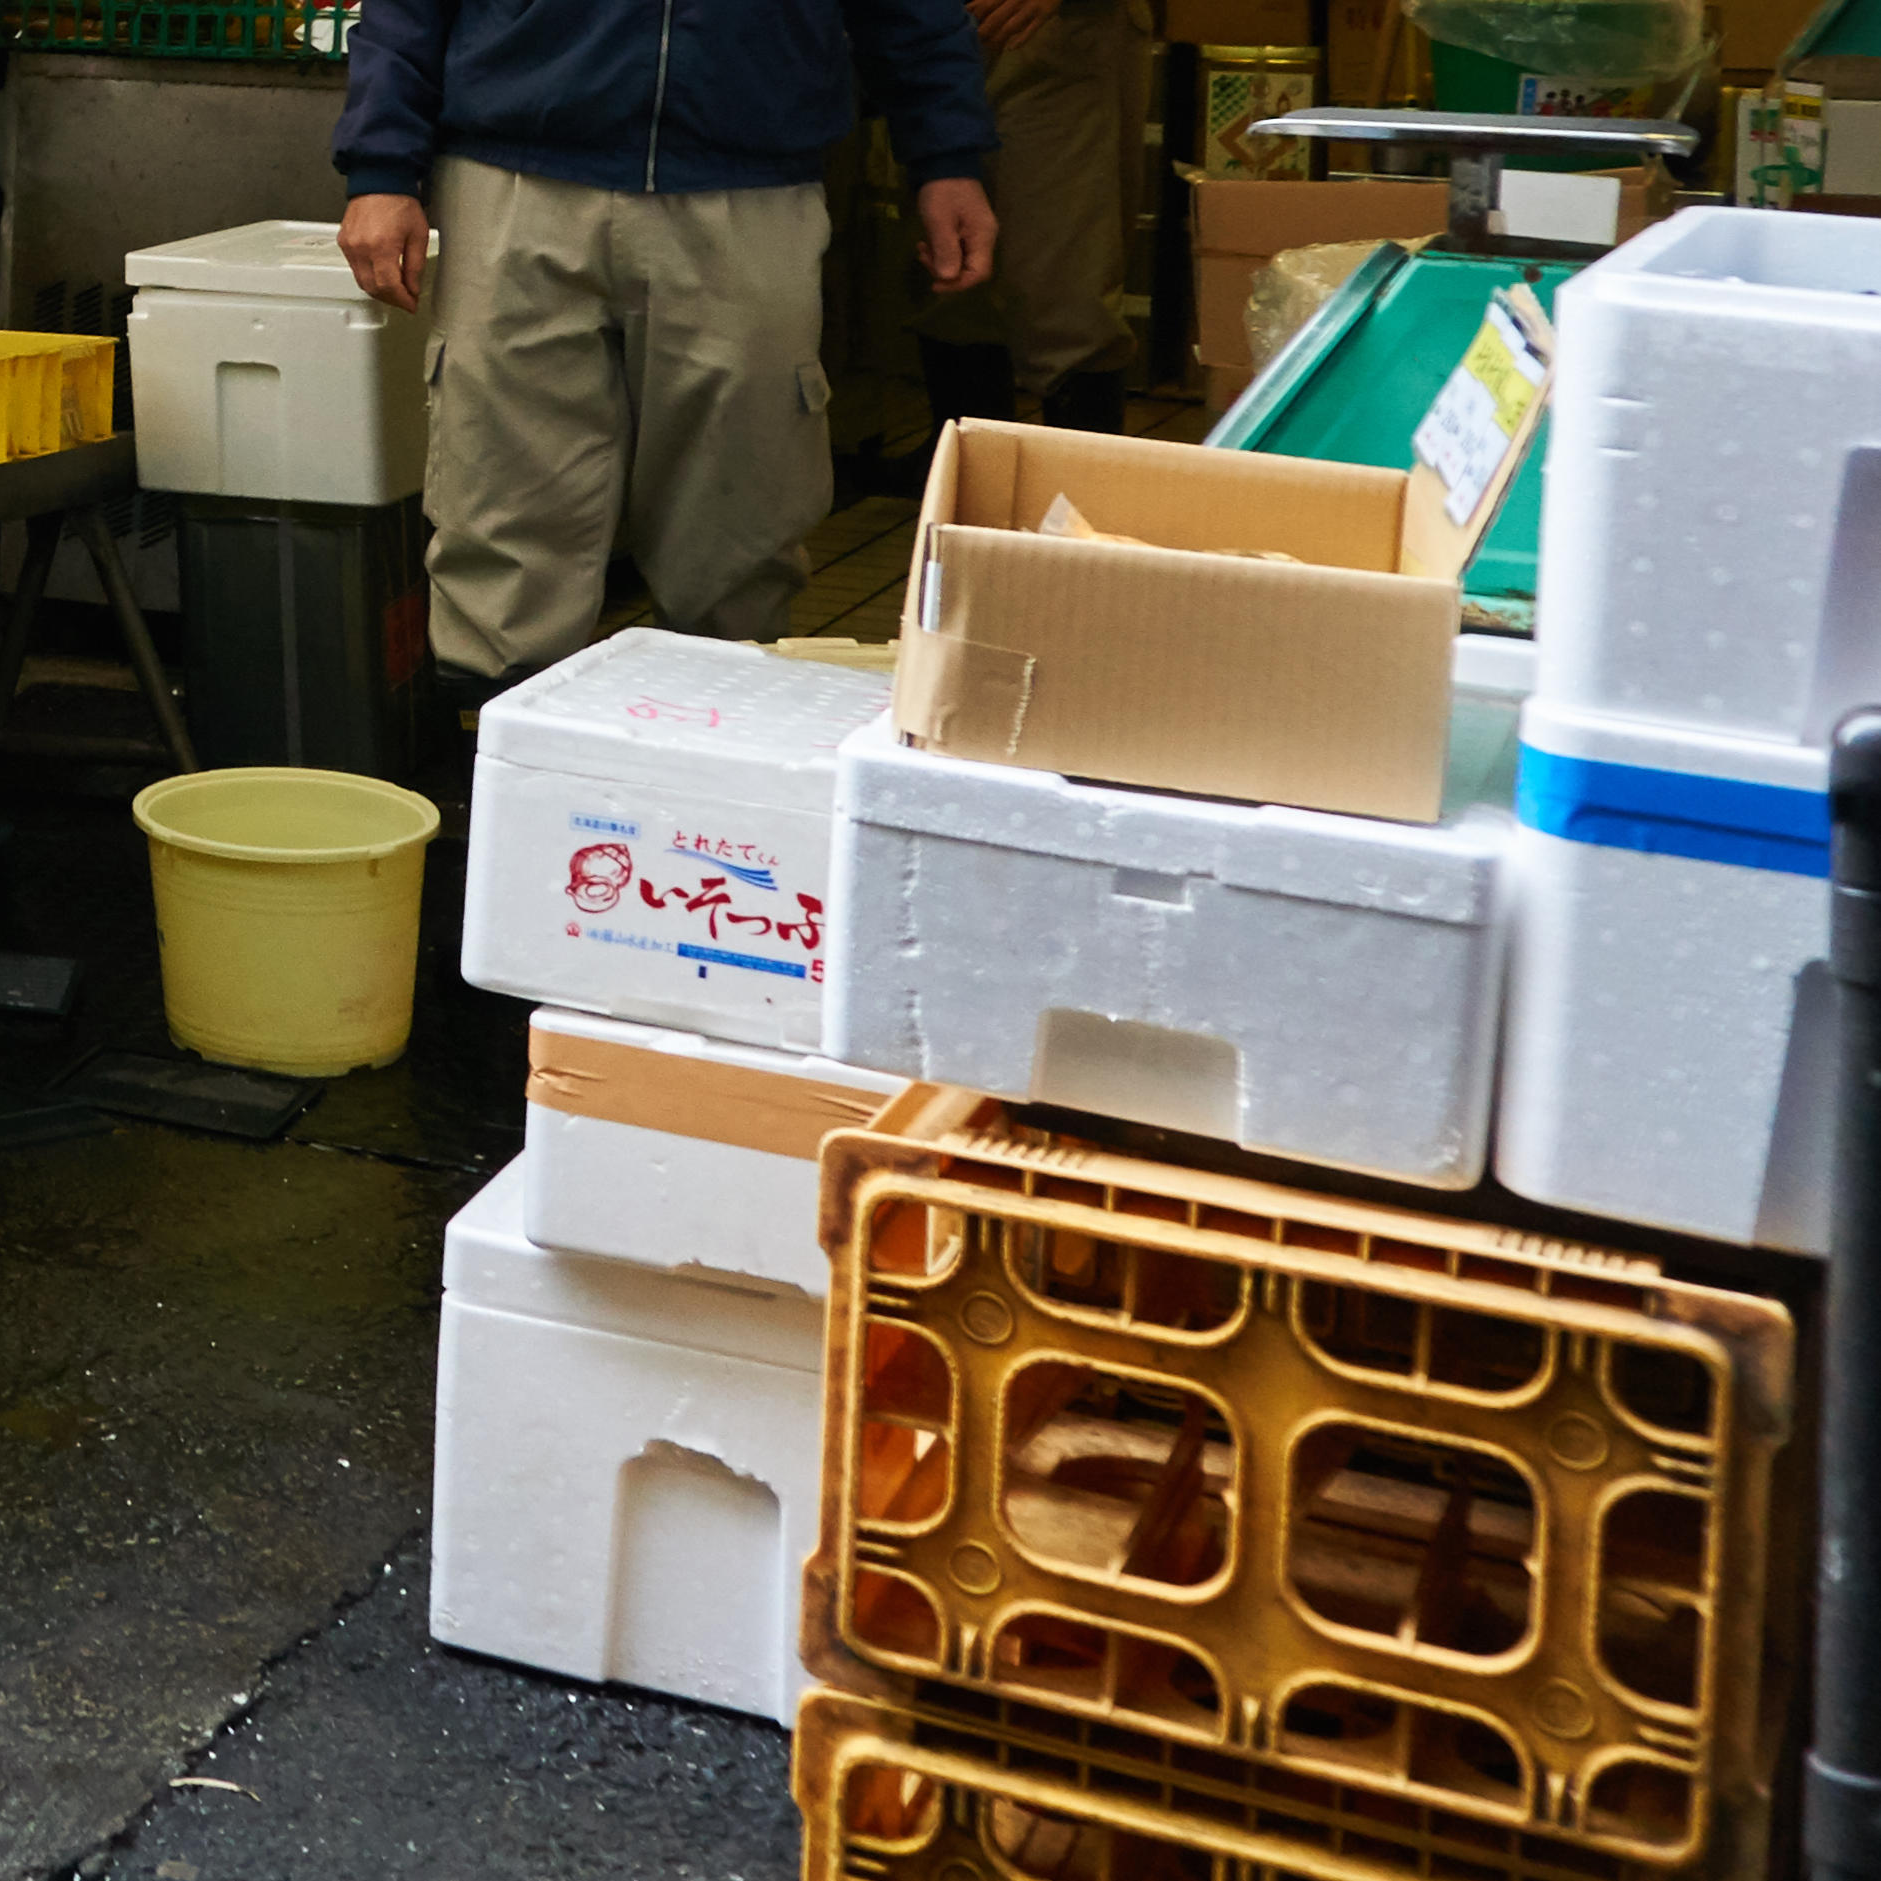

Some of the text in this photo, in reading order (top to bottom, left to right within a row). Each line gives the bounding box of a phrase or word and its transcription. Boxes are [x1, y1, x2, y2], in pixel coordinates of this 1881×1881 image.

[673, 829, 781, 867] とれたてくん
